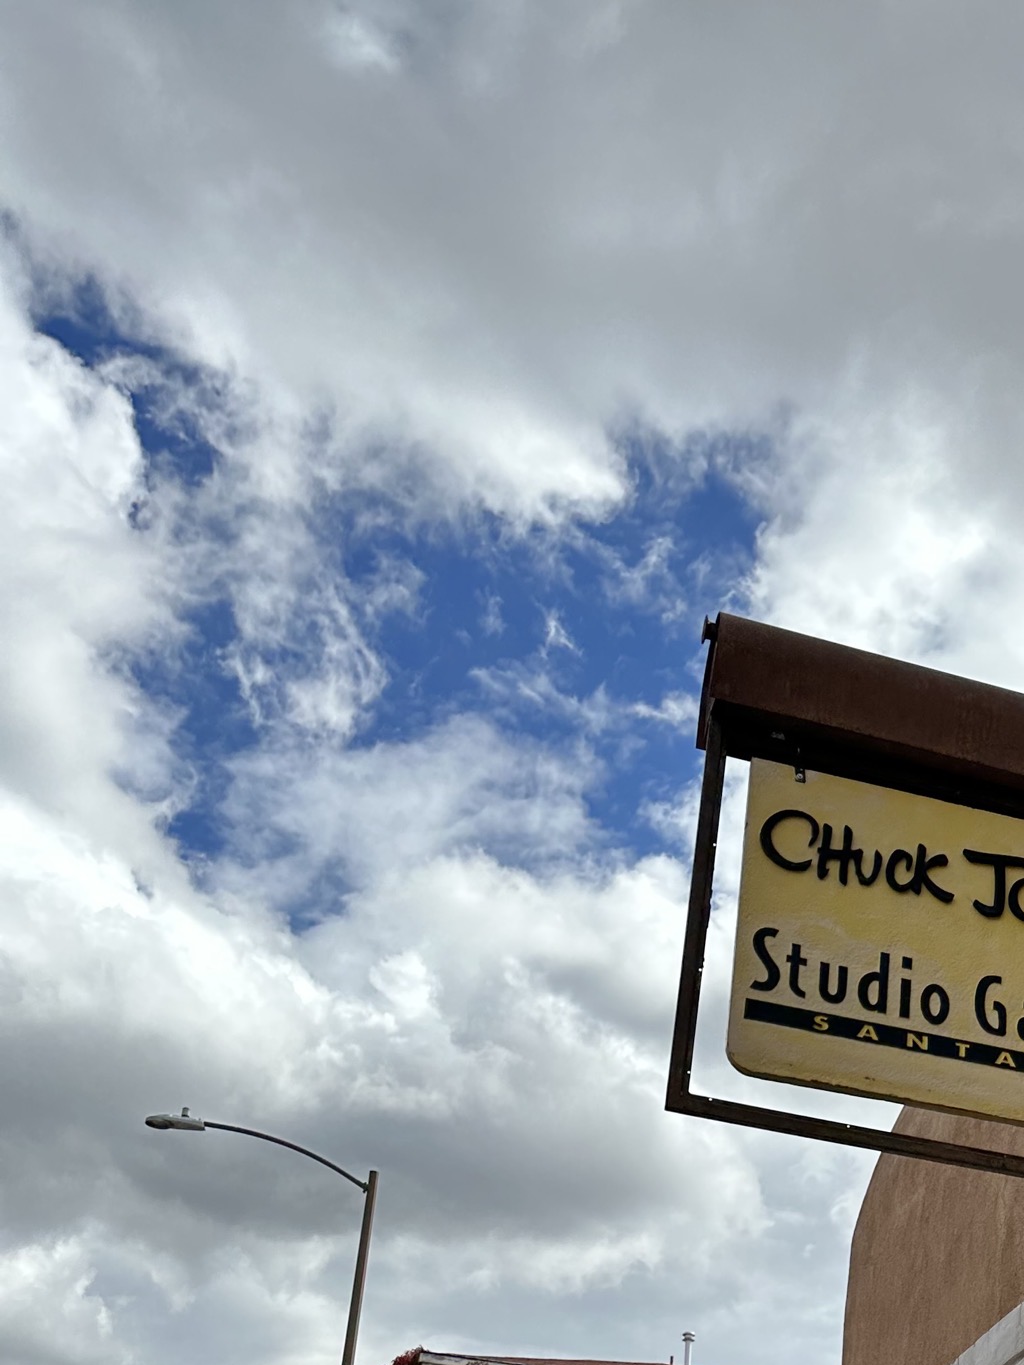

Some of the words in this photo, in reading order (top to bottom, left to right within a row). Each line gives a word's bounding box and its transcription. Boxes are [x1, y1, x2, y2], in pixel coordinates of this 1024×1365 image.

[759, 809, 955, 904] CHUCK
[750, 927, 950, 1036] Studio
[812, 1014, 1017, 1069] SANTA
